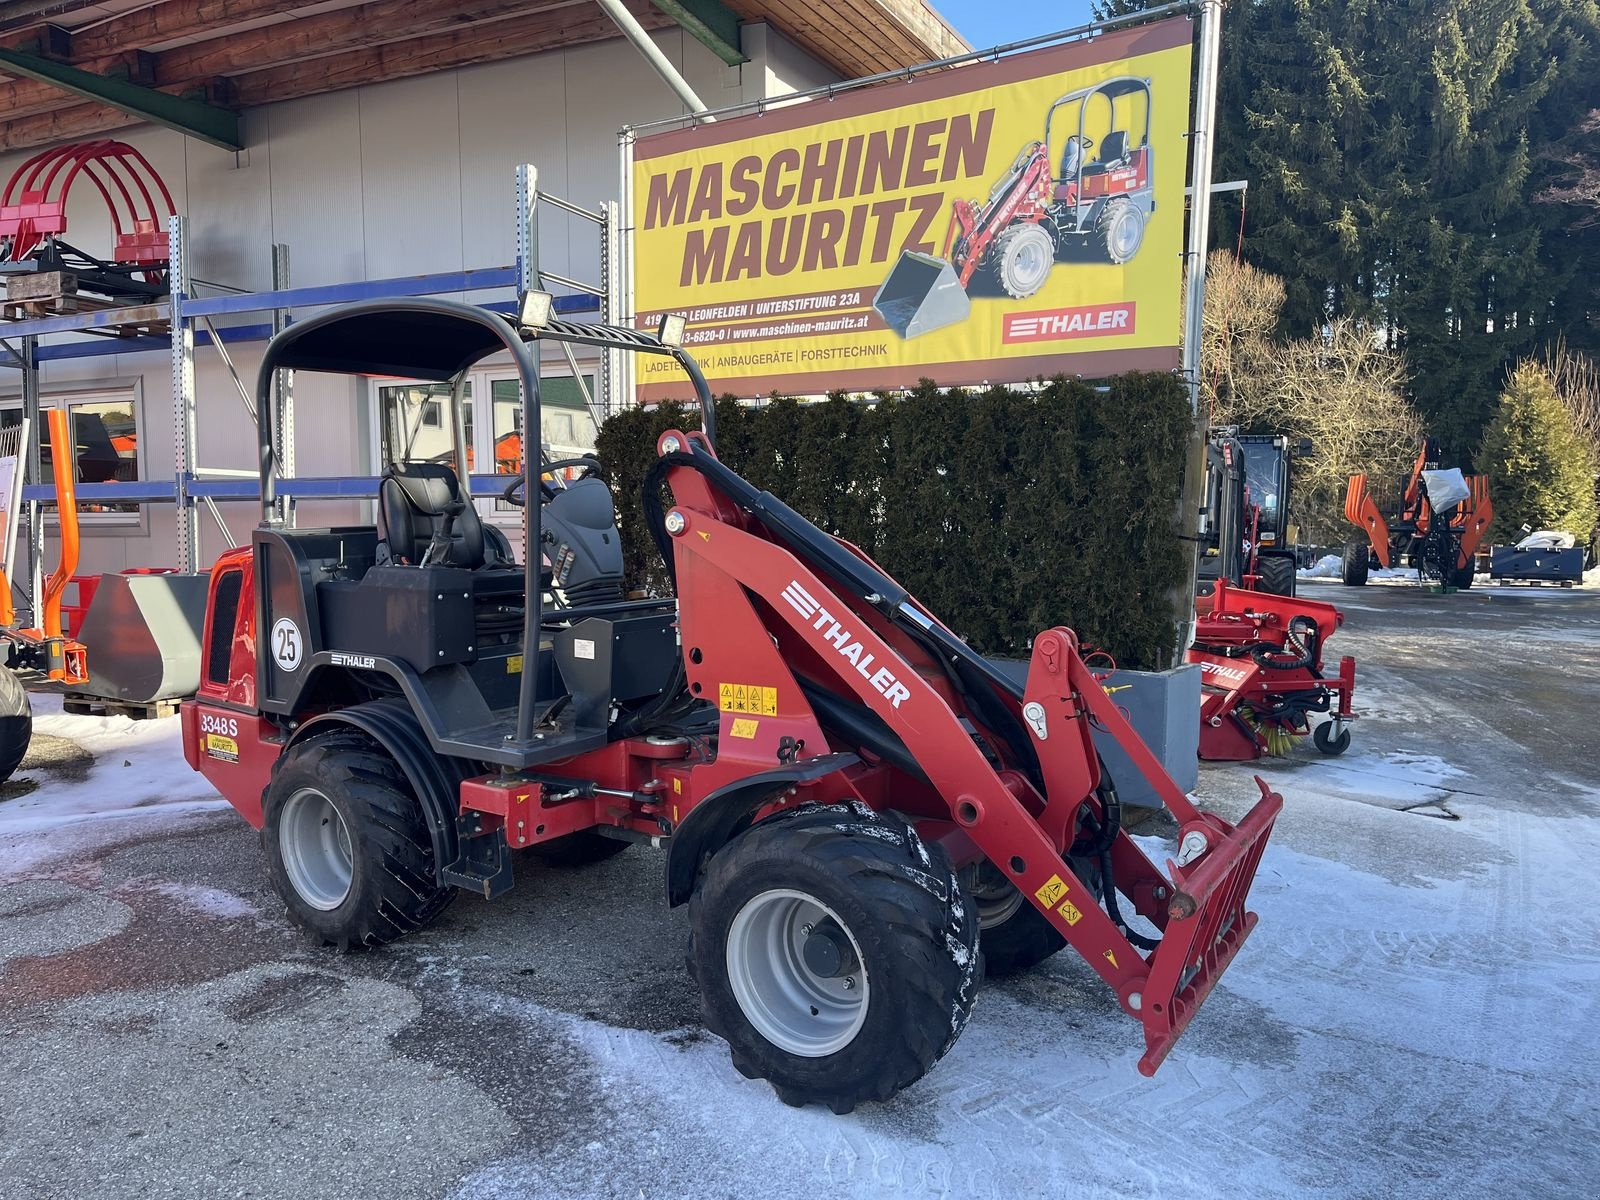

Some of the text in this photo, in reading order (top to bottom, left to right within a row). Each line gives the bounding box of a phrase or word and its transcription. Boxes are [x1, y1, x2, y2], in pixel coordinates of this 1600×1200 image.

[644, 109, 995, 230] MASCHINEN
[680, 192, 944, 288] MAURITZ
[645, 292, 861, 326] 419 LEONFELDEN UNTERSTIFTUNG 23A
[1036, 308, 1129, 335] THALER
[681, 315, 868, 344] 13-6820-0 www.maschinen-mauritz.at
[717, 349, 793, 368] ANBAUGERÄTE
[801, 343, 888, 361] FORSTTECHNIK
[278, 628, 296, 662] 25
[341, 655, 376, 669] THALER
[811, 606, 912, 709] THALER
